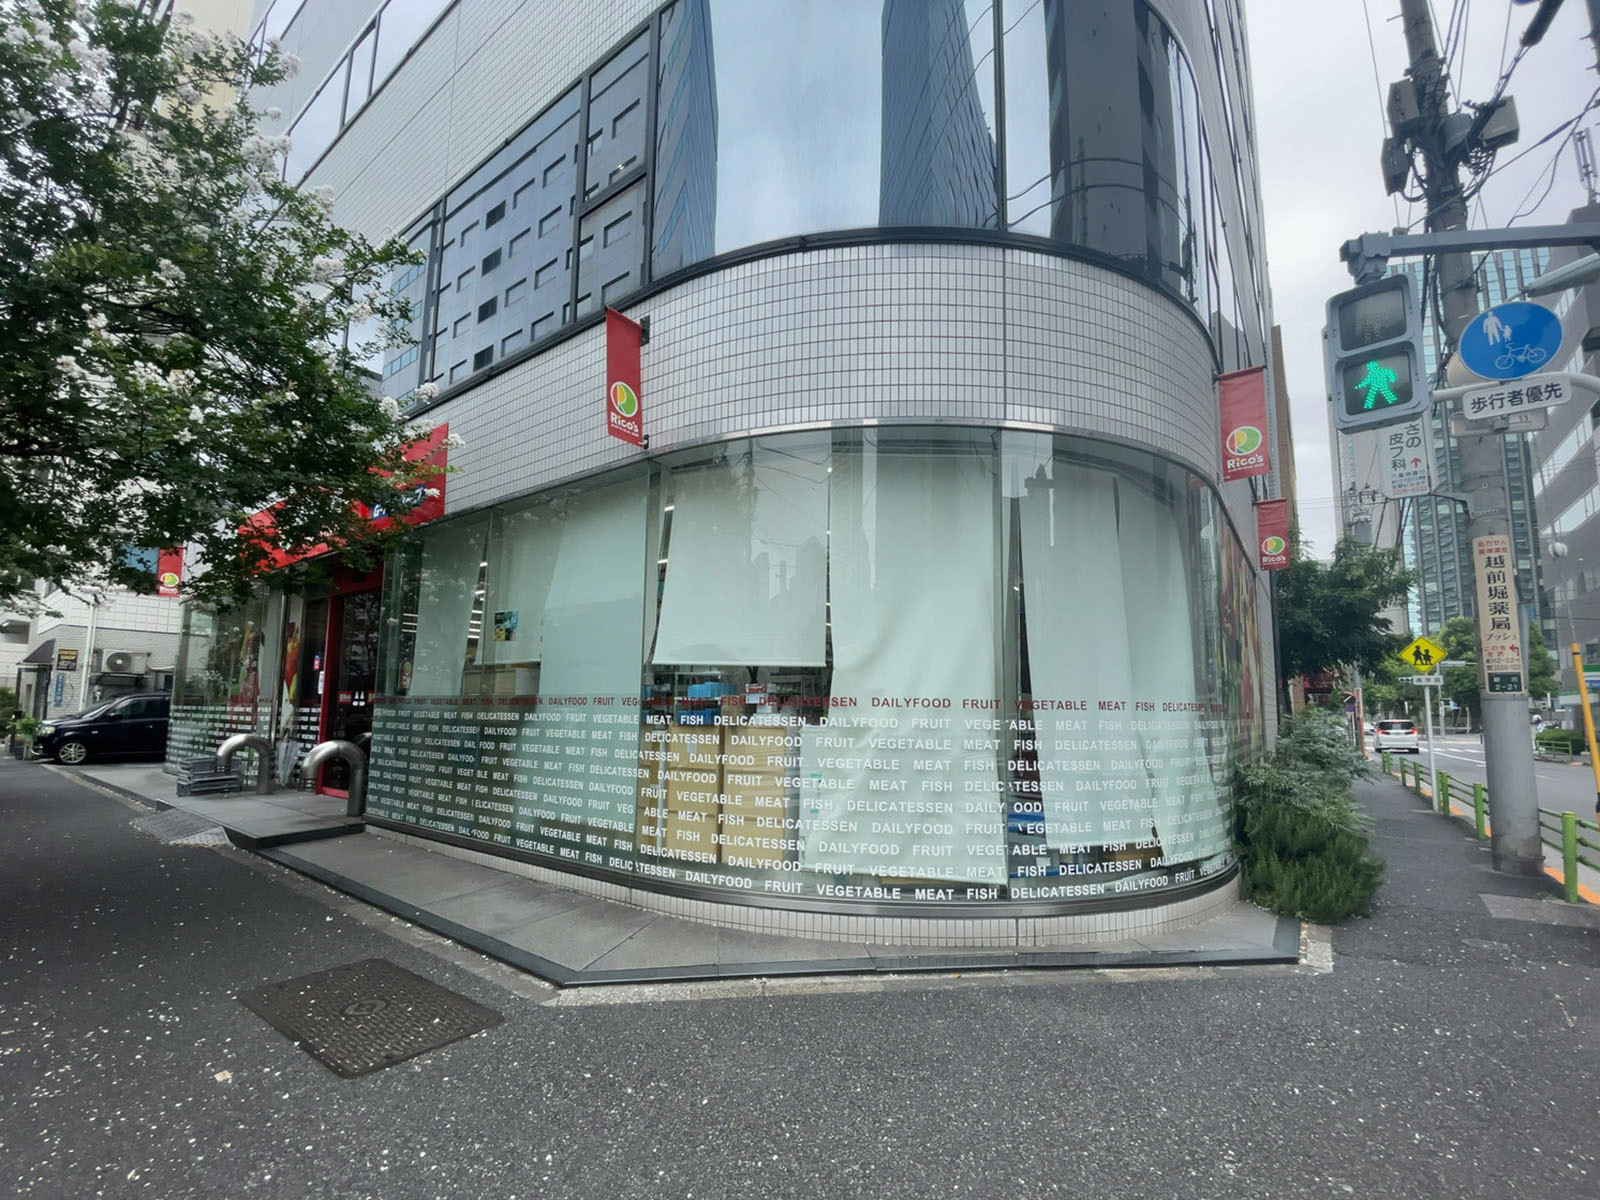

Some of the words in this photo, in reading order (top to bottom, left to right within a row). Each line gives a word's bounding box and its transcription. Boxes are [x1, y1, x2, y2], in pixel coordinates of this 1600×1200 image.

[1470, 382, 1563, 414] 歩行者優先
[1389, 433, 1406, 471] 皮フ科
[1404, 423, 1421, 448] さの
[1484, 555, 1511, 631] 越前堀薬局
[444, 711, 456, 719] MEAT
[461, 711, 472, 720] FISH
[476, 712, 518, 721] DELICATESSEN
[524, 713, 560, 722] DAILYFOOD
[566, 713, 586, 723] FRUIT
[592, 714, 638, 724] VEGETABLE
[646, 714, 670, 724] MEAT
[680, 715, 703, 725] FISH
[713, 715, 806, 727] DELICATESSEN
[819, 717, 898, 729] DAILYFOOD
[911, 718, 951, 730] FRUIT
[1055, 720, 1087, 730] MEAT
[1098, 721, 1121, 730] FISH
[548, 697, 587, 706] DAILYFOOD
[593, 697, 614, 706] FRUIT
[720, 697, 746, 707] FISH
[759, 697, 857, 708] DELICATESSEN
[871, 698, 951, 709] DAILYFOOD
[962, 699, 1000, 710] FRUIT
[1014, 700, 1086, 711] VEGETABLE
[1098, 701, 1125, 711] MEAT
[1135, 702, 1154, 711] FISH
[397, 735, 408, 743] MEAT
[424, 737, 460, 747] DELICATESSEN
[499, 742, 516, 751] FRUIT
[521, 743, 559, 754] VEGETABLE
[565, 746, 584, 756] MEAT
[590, 747, 607, 757] FISH
[614, 748, 679, 762] DELICATESSEN
[689, 753, 754, 766] DAILYFOOD
[767, 756, 804, 768] FRUIT
[817, 758, 899, 770] VEGETABLE
[913, 760, 951, 770] MEAT
[964, 760, 993, 770] FISH
[1007, 760, 1100, 770] DELICATESSEN
[1110, 759, 1162, 770] DAILYFOOD
[412, 723, 424, 731] MEAT
[427, 724, 438, 732] FISH
[484, 726, 516, 736] DAILYFOOD
[521, 727, 539, 737] FRUIT
[545, 728, 585, 739] VEGETABLE
[591, 730, 611, 740] MEAT
[619, 731, 637, 741] FISH
[644, 732, 719, 745] DELICATESSEN
[731, 735, 801, 747] DAILYFOOD
[816, 737, 854, 748] FRUIT
[869, 738, 951, 750] VEGETABLE
[963, 739, 1000, 750] MEAT
[1013, 740, 1042, 750] FISH
[1055, 740, 1137, 750] DELICATESSEN
[410, 749, 444, 760] DELICATESSEN
[481, 756, 497, 765] FRUIT
[502, 757, 537, 769] VEGETABLE
[544, 761, 561, 771] MEAT
[568, 763, 584, 773] FISH
[590, 765, 649, 779] DELICATESSEN
[658, 770, 716, 784] DAILYFOOD
[727, 774, 762, 786] FRUIT
[774, 777, 854, 790] VEGETABLE
[869, 780, 907, 791] MEAT
[922, 781, 952, 791] FISH
[1075, 779, 1136, 790] DAILYFOOD
[1145, 778, 1168, 788] FRUIT
[438, 765, 452, 774] FRUIT
[457, 767, 487, 778] VEGETBLE
[492, 771, 508, 781] MEAT
[513, 773, 527, 783] FISH
[532, 775, 583, 790] DELICATESSEN
[588, 782, 633, 796] DAILYFOOD
[641, 787, 667, 799] FRUIT
[676, 790, 742, 806] VEGETABLE
[755, 796, 789, 808] MEAT
[803, 799, 832, 811] FISH
[847, 801, 952, 813] DELICATESSEN
[1055, 801, 1088, 812] FRUIT
[1100, 798, 1157, 810] VEGETABLE
[408, 774, 421, 784] FRUIT
[424, 777, 452, 788] VEGETABLE
[456, 781, 470, 791] MEAT
[475, 784, 488, 794] FISH
[492, 786, 537, 801] DELICATESSEN
[543, 793, 582, 807] DAILYFOOD
[587, 799, 609, 811] FRUIT
[678, 810, 707, 823] MEAT
[718, 814, 744, 826] FISH
[756, 817, 857, 833] DELICATESSEN
[872, 823, 952, 834] DAILYFOOD
[966, 823, 1005, 834] FRUIT
[1103, 820, 1131, 831] MEAT
[1140, 817, 1160, 828] FISH
[406, 801, 419, 811] MEAT
[422, 804, 433, 814] FISH
[436, 807, 474, 822] DELICATESSEN
[478, 815, 511, 829] DAILYFOOD
[516, 822, 534, 834] FRUIT
[540, 826, 580, 843] VEGETABLE
[586, 835, 607, 847] MEAT
[614, 839, 632, 852] FISH
[640, 844, 716, 864] DELICATESSEN
[728, 855, 800, 872] DAILYFOOD
[815, 863, 854, 875] FRUIT
[869, 865, 952, 877] VEGETABLE
[966, 867, 1004, 877] MEAT
[1017, 866, 1046, 877] FISH
[1059, 860, 1141, 875] DELICATESSEN
[438, 793, 451, 803] MEAT
[455, 796, 467, 806] FISH
[518, 806, 555, 821] DAILYFOOD
[560, 813, 581, 825] FRUIT
[587, 817, 633, 833] VEGETABLE
[641, 825, 667, 838] MEAT
[676, 829, 700, 842] FISH
[711, 833, 804, 851] DELICATESSEN
[819, 841, 899, 855] DAILYFOOD
[913, 845, 952, 856] FRUIT
[1059, 843, 1091, 854] MEAT
[1102, 841, 1126, 852] FISH
[1135, 831, 1194, 849] DELICATESSEN
[418, 817, 454, 832] DELICATESSEN
[494, 833, 510, 845] FRUIT
[516, 838, 553, 855] VEGETABLE
[560, 848, 579, 861] MEAT
[585, 853, 602, 865] FISH
[685, 871, 752, 889] DAILYFOOD
[765, 880, 802, 894] FRUIT
[816, 884, 901, 899] VEGETABLE
[914, 888, 954, 899] MEAT
[967, 888, 997, 899] FISH
[1011, 884, 1104, 898] DELICATESSEN
[1115, 875, 1168, 892] DAILYFOOD
[1175, 870, 1194, 882] FRUIT
